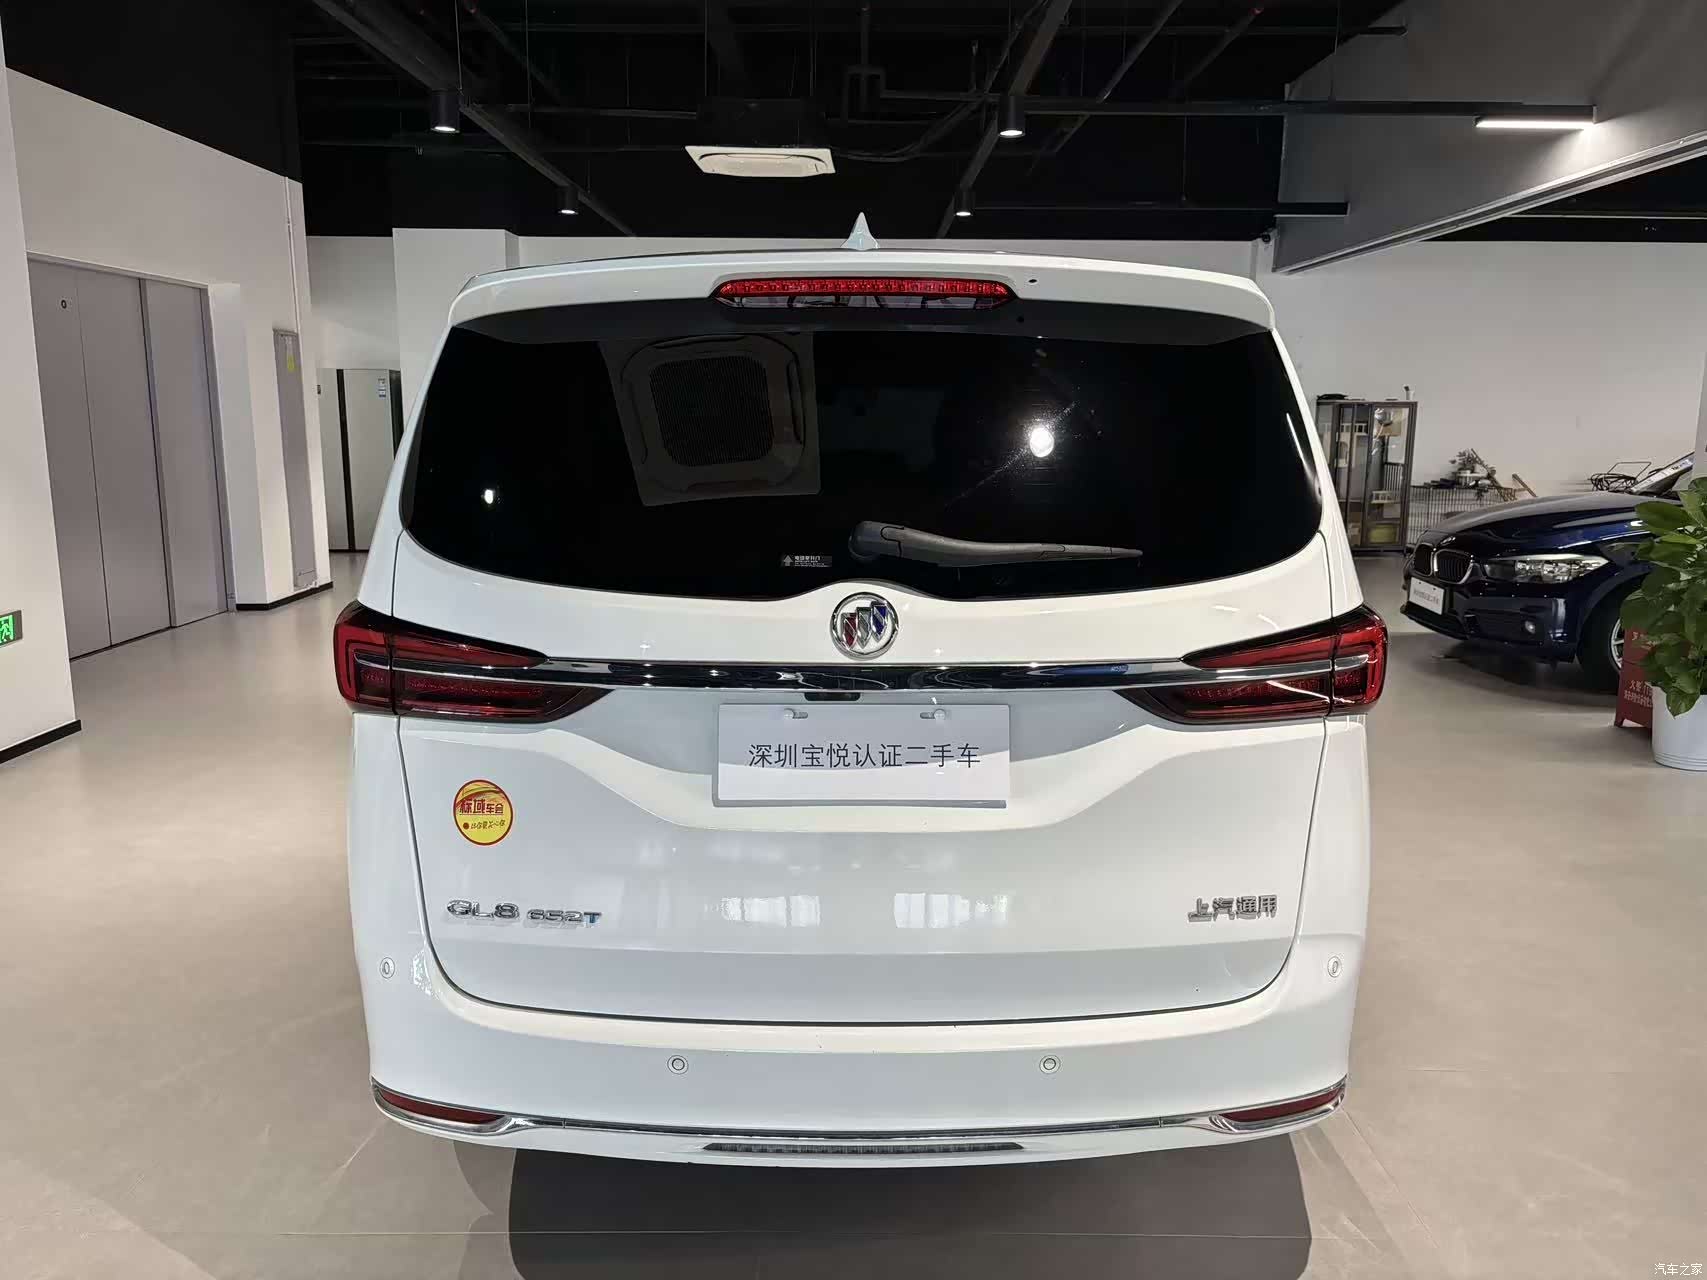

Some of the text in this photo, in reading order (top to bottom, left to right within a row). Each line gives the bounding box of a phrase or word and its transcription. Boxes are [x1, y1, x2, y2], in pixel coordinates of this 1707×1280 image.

[748, 742, 981, 769] 深圳宝悦认证二手车
[446, 899, 603, 924] GL8 652T
[1187, 894, 1278, 923] 上汽通用
